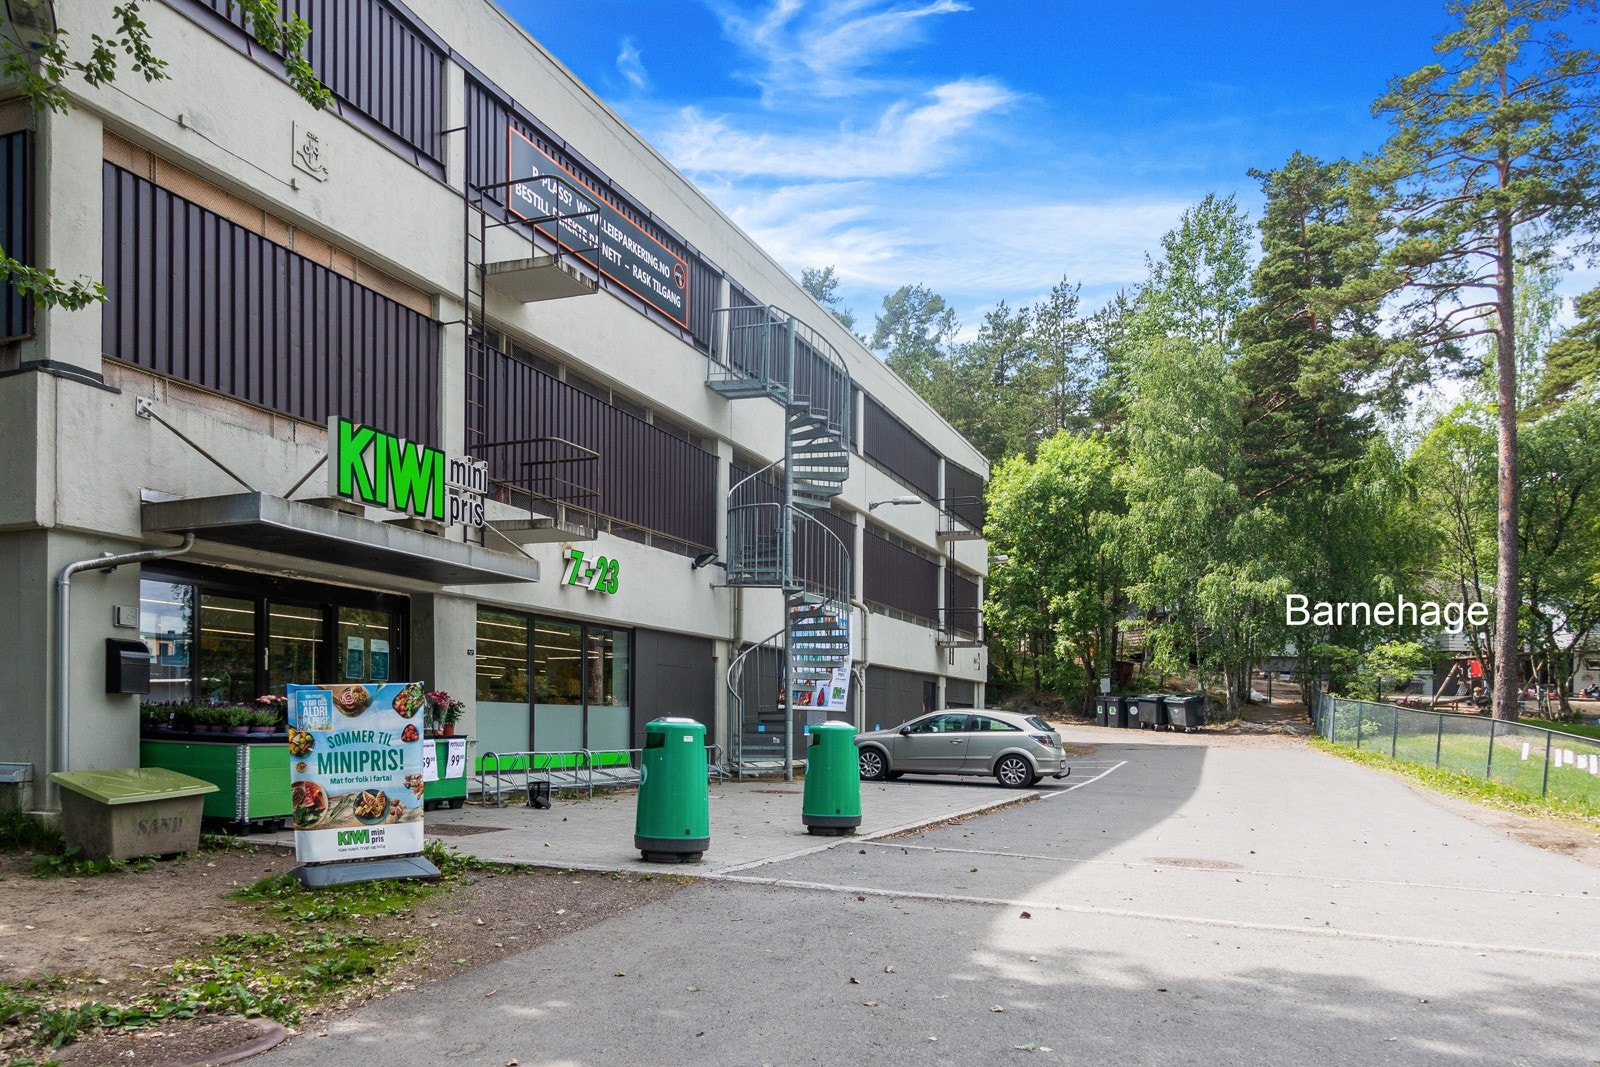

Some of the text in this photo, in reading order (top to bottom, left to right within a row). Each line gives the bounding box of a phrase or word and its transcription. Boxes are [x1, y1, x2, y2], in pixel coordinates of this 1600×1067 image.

[515, 183, 550, 216] BESTILL
[602, 242, 622, 267] NETT
[632, 264, 651, 288] RASK
[652, 278, 681, 308] TILGANG
[338, 415, 446, 522] KIWI
[450, 456, 489, 493] mini
[450, 493, 484, 527] pris
[303, 706, 328, 717] ALDRI
[327, 730, 392, 749] SOMMER TIL
[317, 749, 404, 775] MINIPRIS!
[330, 777, 344, 785] Mat
[345, 776, 355, 784] for
[355, 775, 370, 783] folk
[373, 774, 392, 782] farta!
[137, 816, 183, 836] SAND
[371, 827, 386, 836] mini
[337, 829, 370, 846] KIWI
[371, 835, 385, 845] pris
